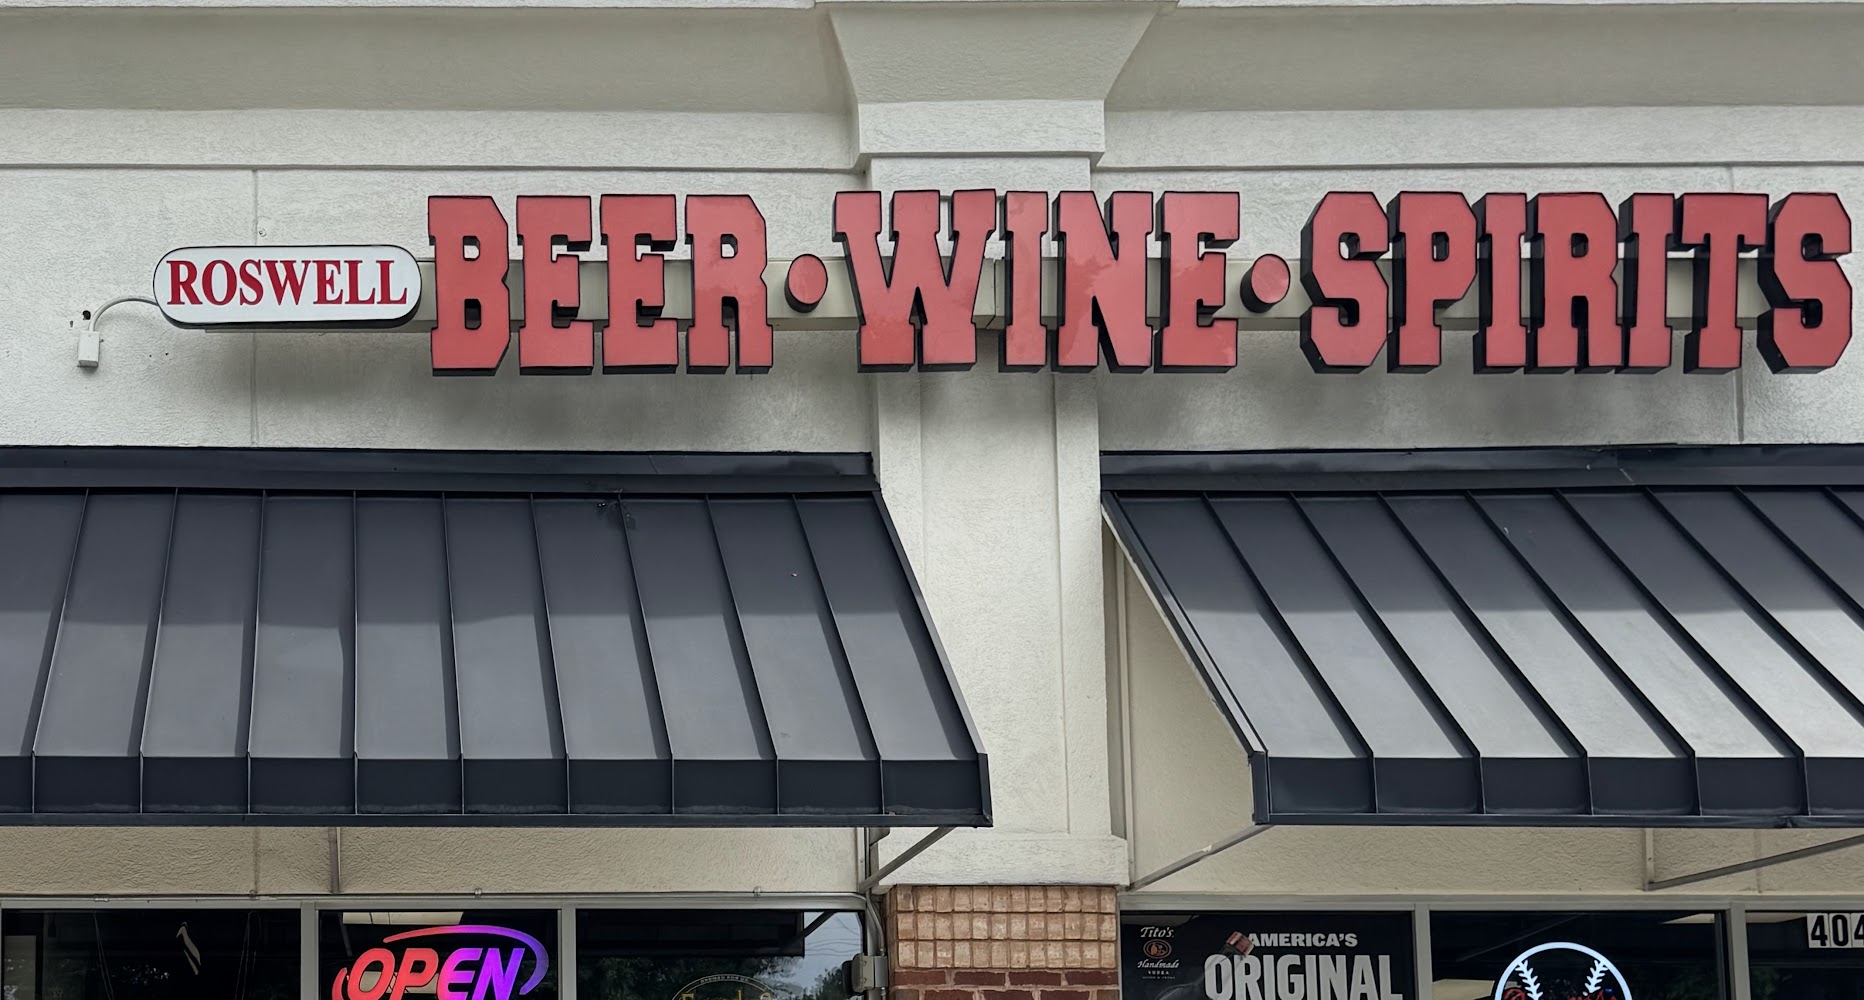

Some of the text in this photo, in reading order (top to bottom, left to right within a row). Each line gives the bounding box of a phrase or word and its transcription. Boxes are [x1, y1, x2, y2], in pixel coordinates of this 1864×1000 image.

[166, 259, 407, 306] ROSWELL
[427, 189, 1852, 374] BEER WINE SPIRITS
[1140, 926, 1174, 938] Tito's
[1249, 933, 1358, 947] AMERICA'S
[1137, 959, 1179, 969] Handmade
